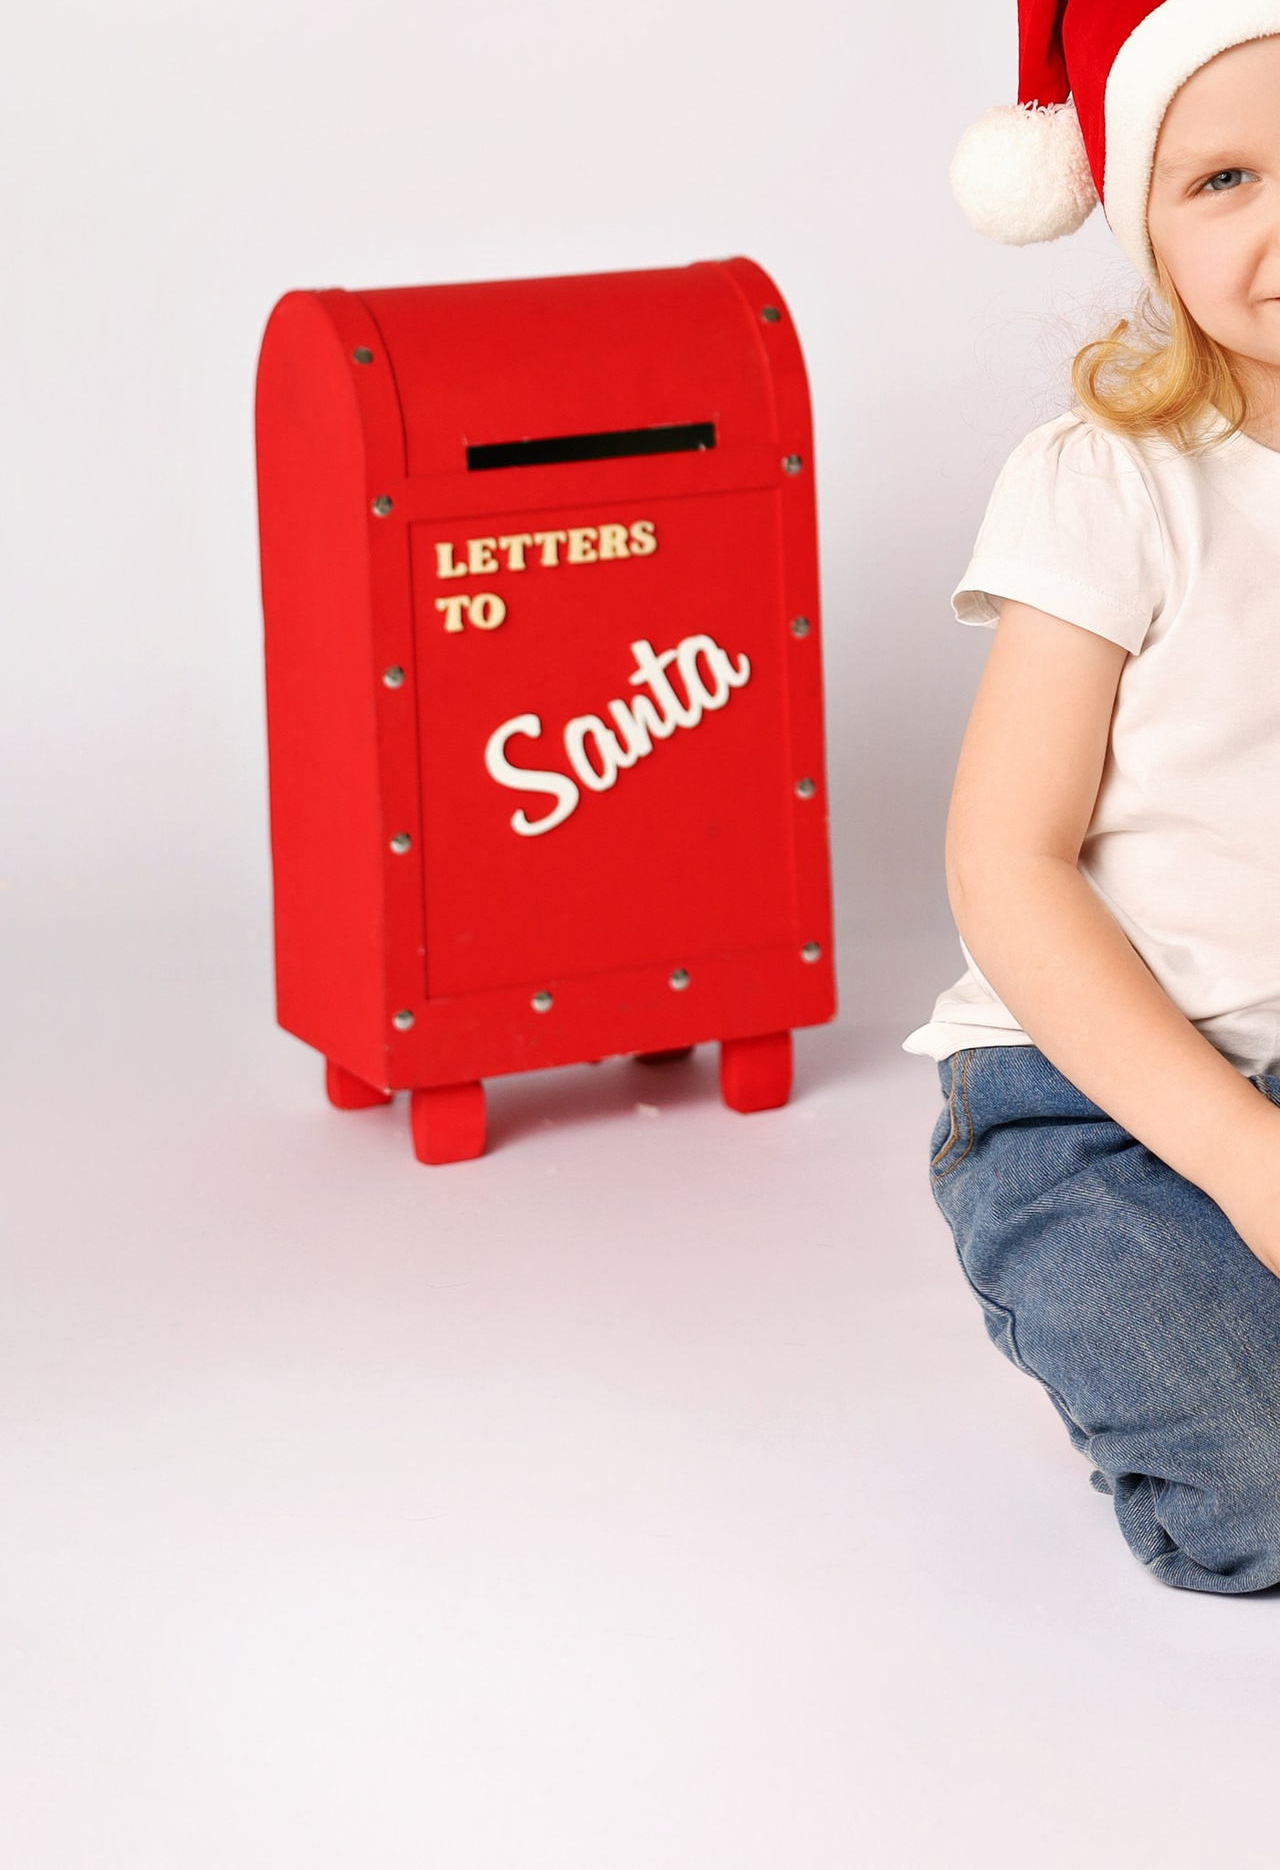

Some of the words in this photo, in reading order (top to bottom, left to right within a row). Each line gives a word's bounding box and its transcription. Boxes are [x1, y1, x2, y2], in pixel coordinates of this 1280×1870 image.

[436, 521, 657, 578] LETTERS
[436, 593, 506, 632] TO
[485, 634, 750, 836] Santa
